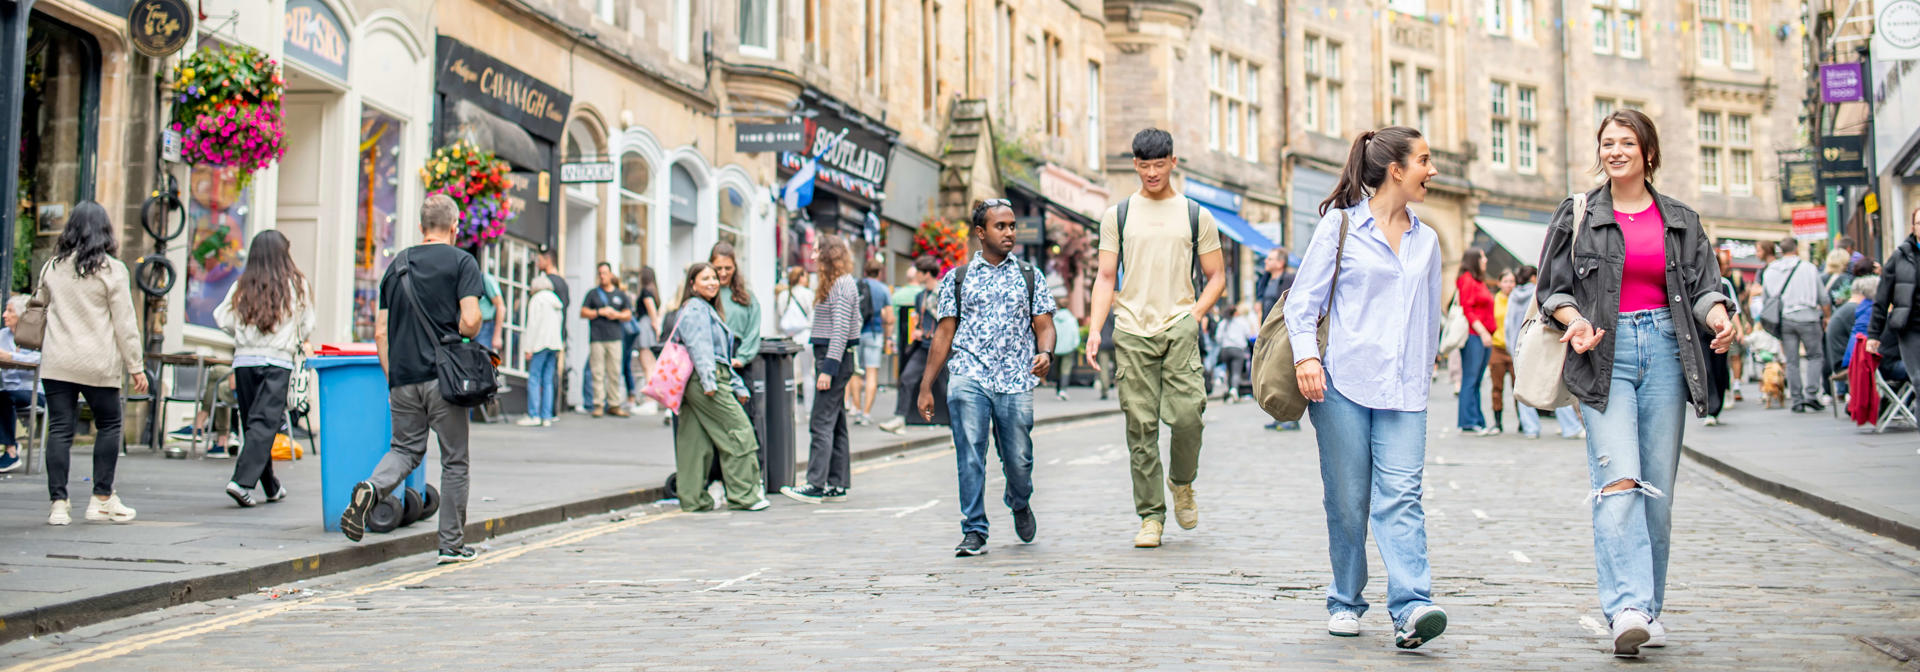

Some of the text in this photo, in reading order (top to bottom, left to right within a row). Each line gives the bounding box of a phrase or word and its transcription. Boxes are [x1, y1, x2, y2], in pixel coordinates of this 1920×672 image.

[283, 6, 346, 67] PIE SKY
[480, 66, 548, 119] CAVANAGH
[812, 126, 887, 184] SCOTLAND
